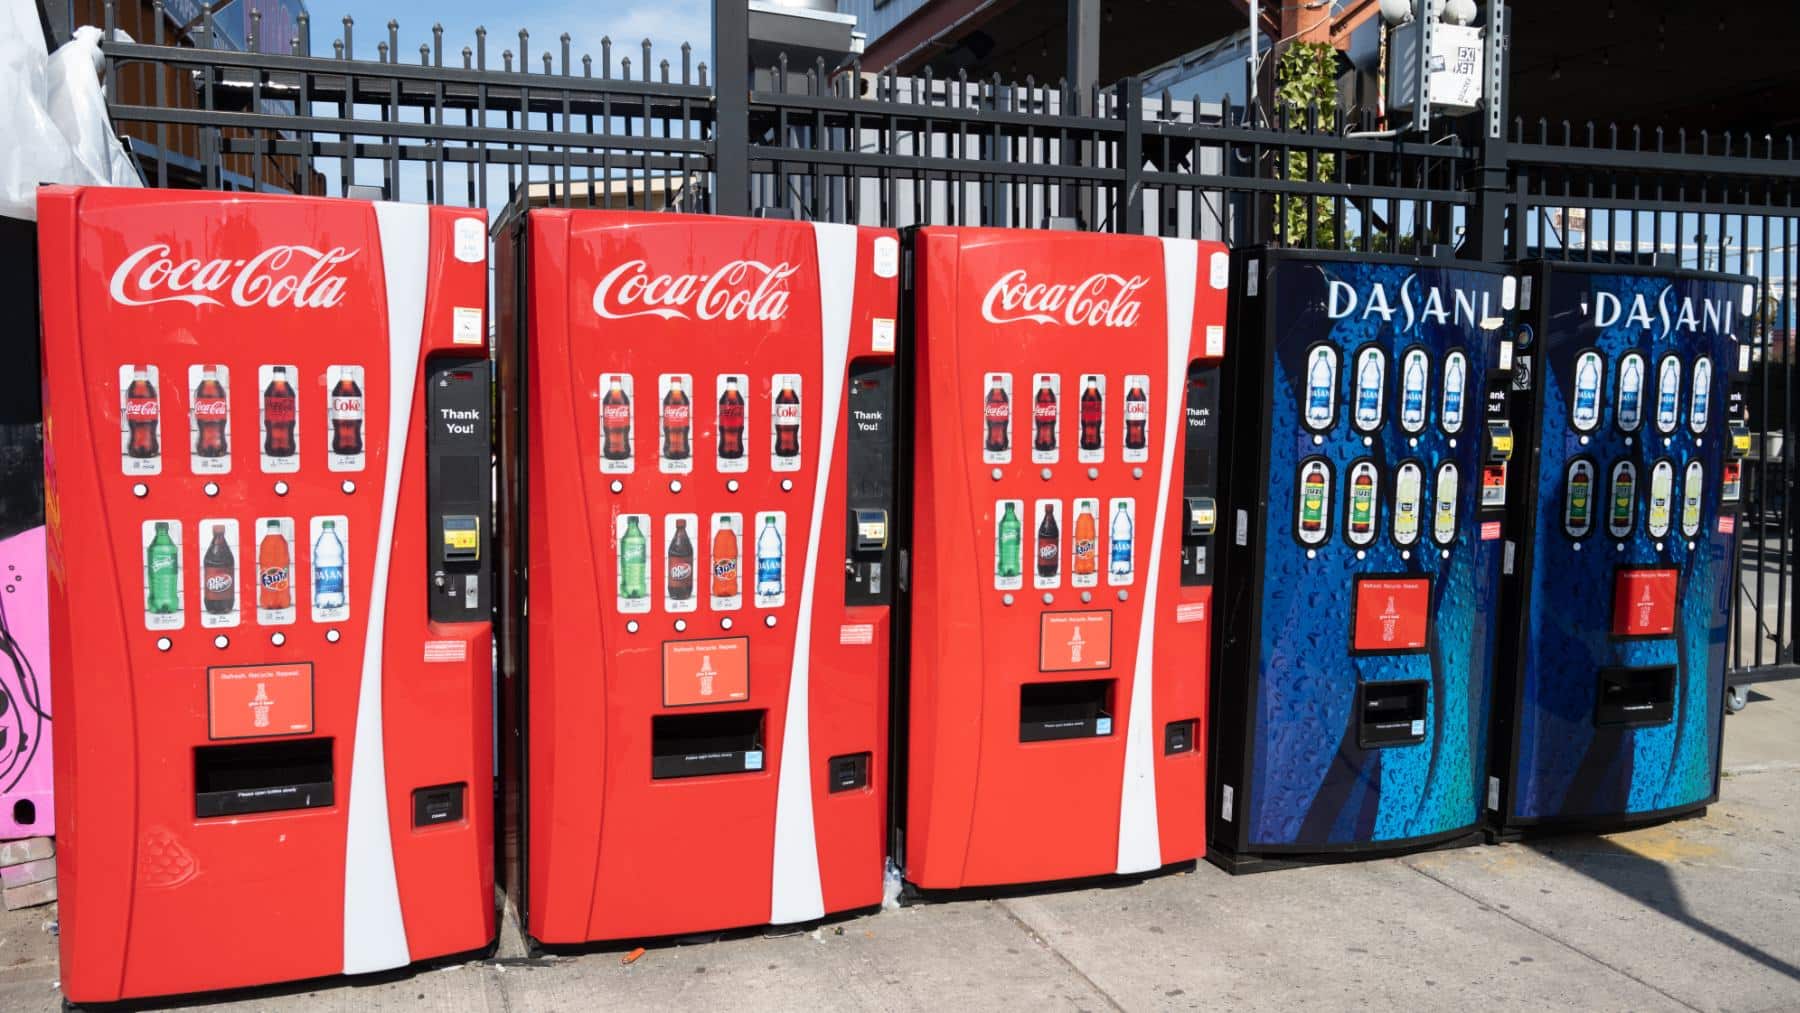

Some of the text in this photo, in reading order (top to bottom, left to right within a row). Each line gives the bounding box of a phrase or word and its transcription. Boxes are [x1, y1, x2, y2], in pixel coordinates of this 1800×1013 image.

[110, 244, 360, 309] Coca-Cola
[593, 260, 800, 321] Coca-Cola
[981, 269, 1150, 328] Coca-Cola
[1594, 284, 1733, 341] DASANI
[1489, 391, 1505, 400] ank
[333, 399, 361, 412] Coke
[441, 409, 479, 420] Thank
[854, 411, 882, 420] Thank
[1186, 408, 1209, 416] Thank
[858, 422, 878, 431] You!
[1189, 418, 1206, 426] You!
[446, 423, 474, 434] You!
